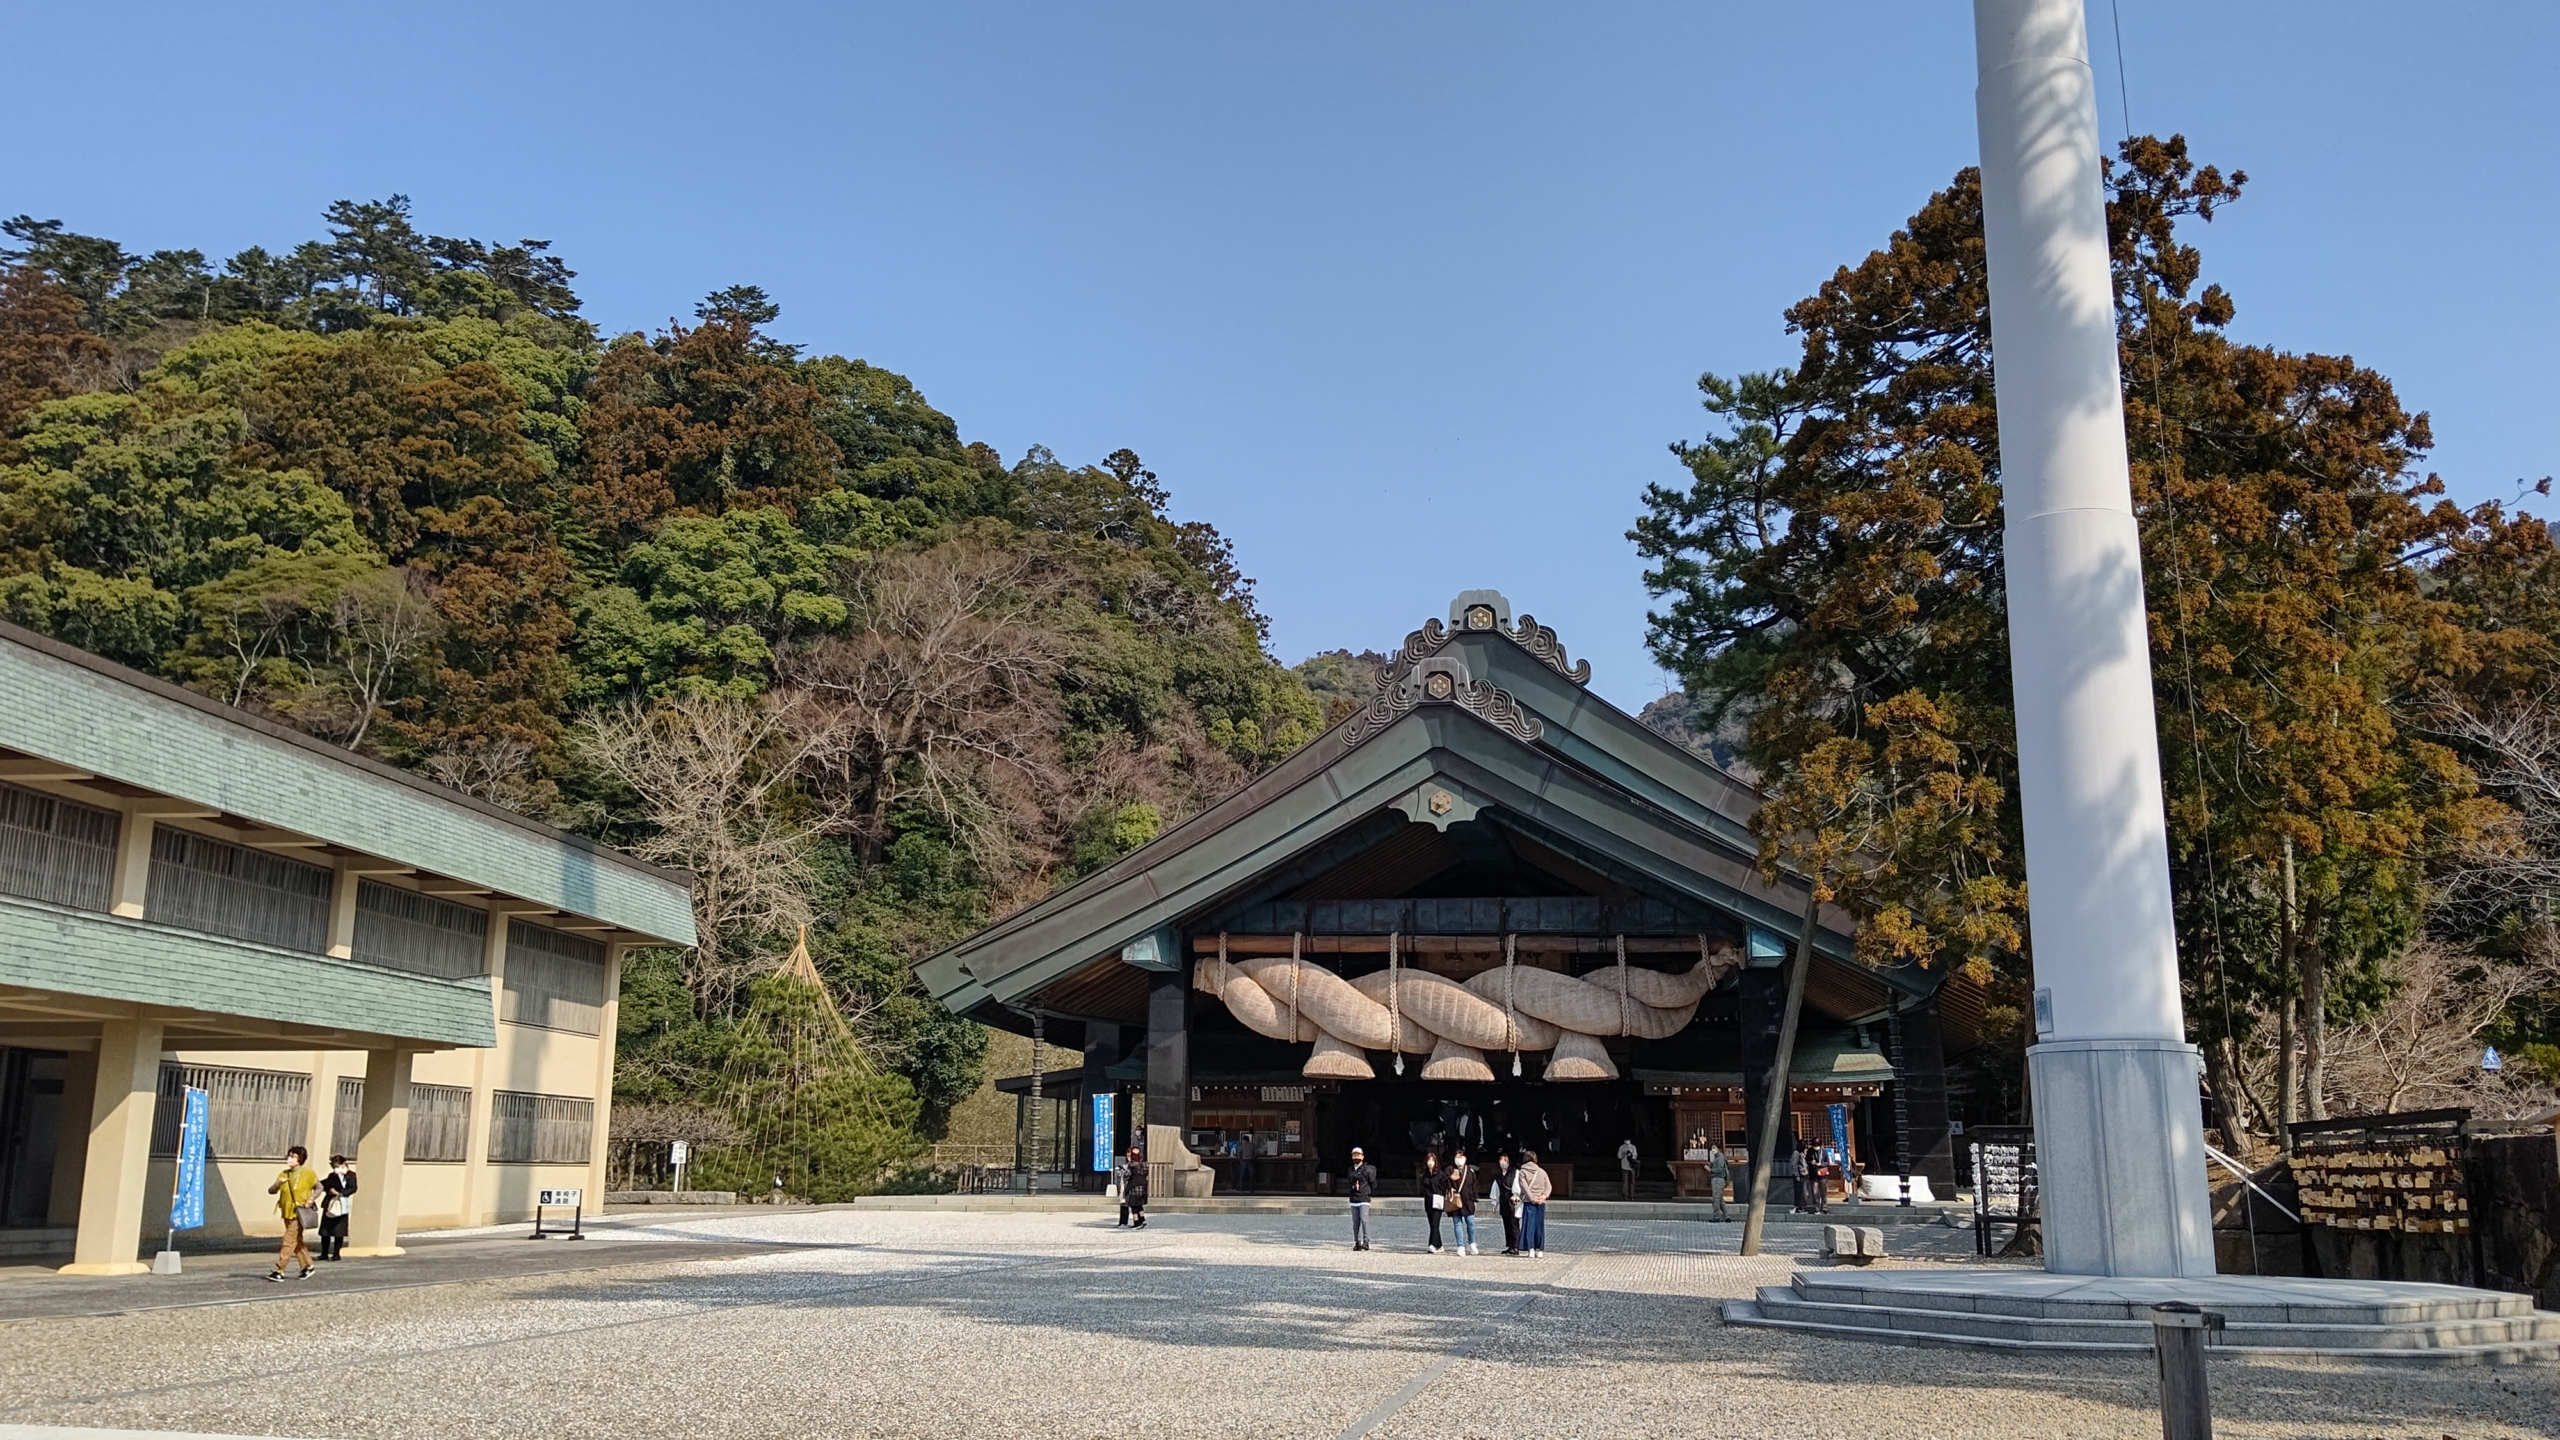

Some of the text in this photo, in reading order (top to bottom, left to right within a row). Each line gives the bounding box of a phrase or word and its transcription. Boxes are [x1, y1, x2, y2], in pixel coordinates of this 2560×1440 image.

[556, 1190, 578, 1198] 車椅子
[555, 1197, 569, 1205] 通路
